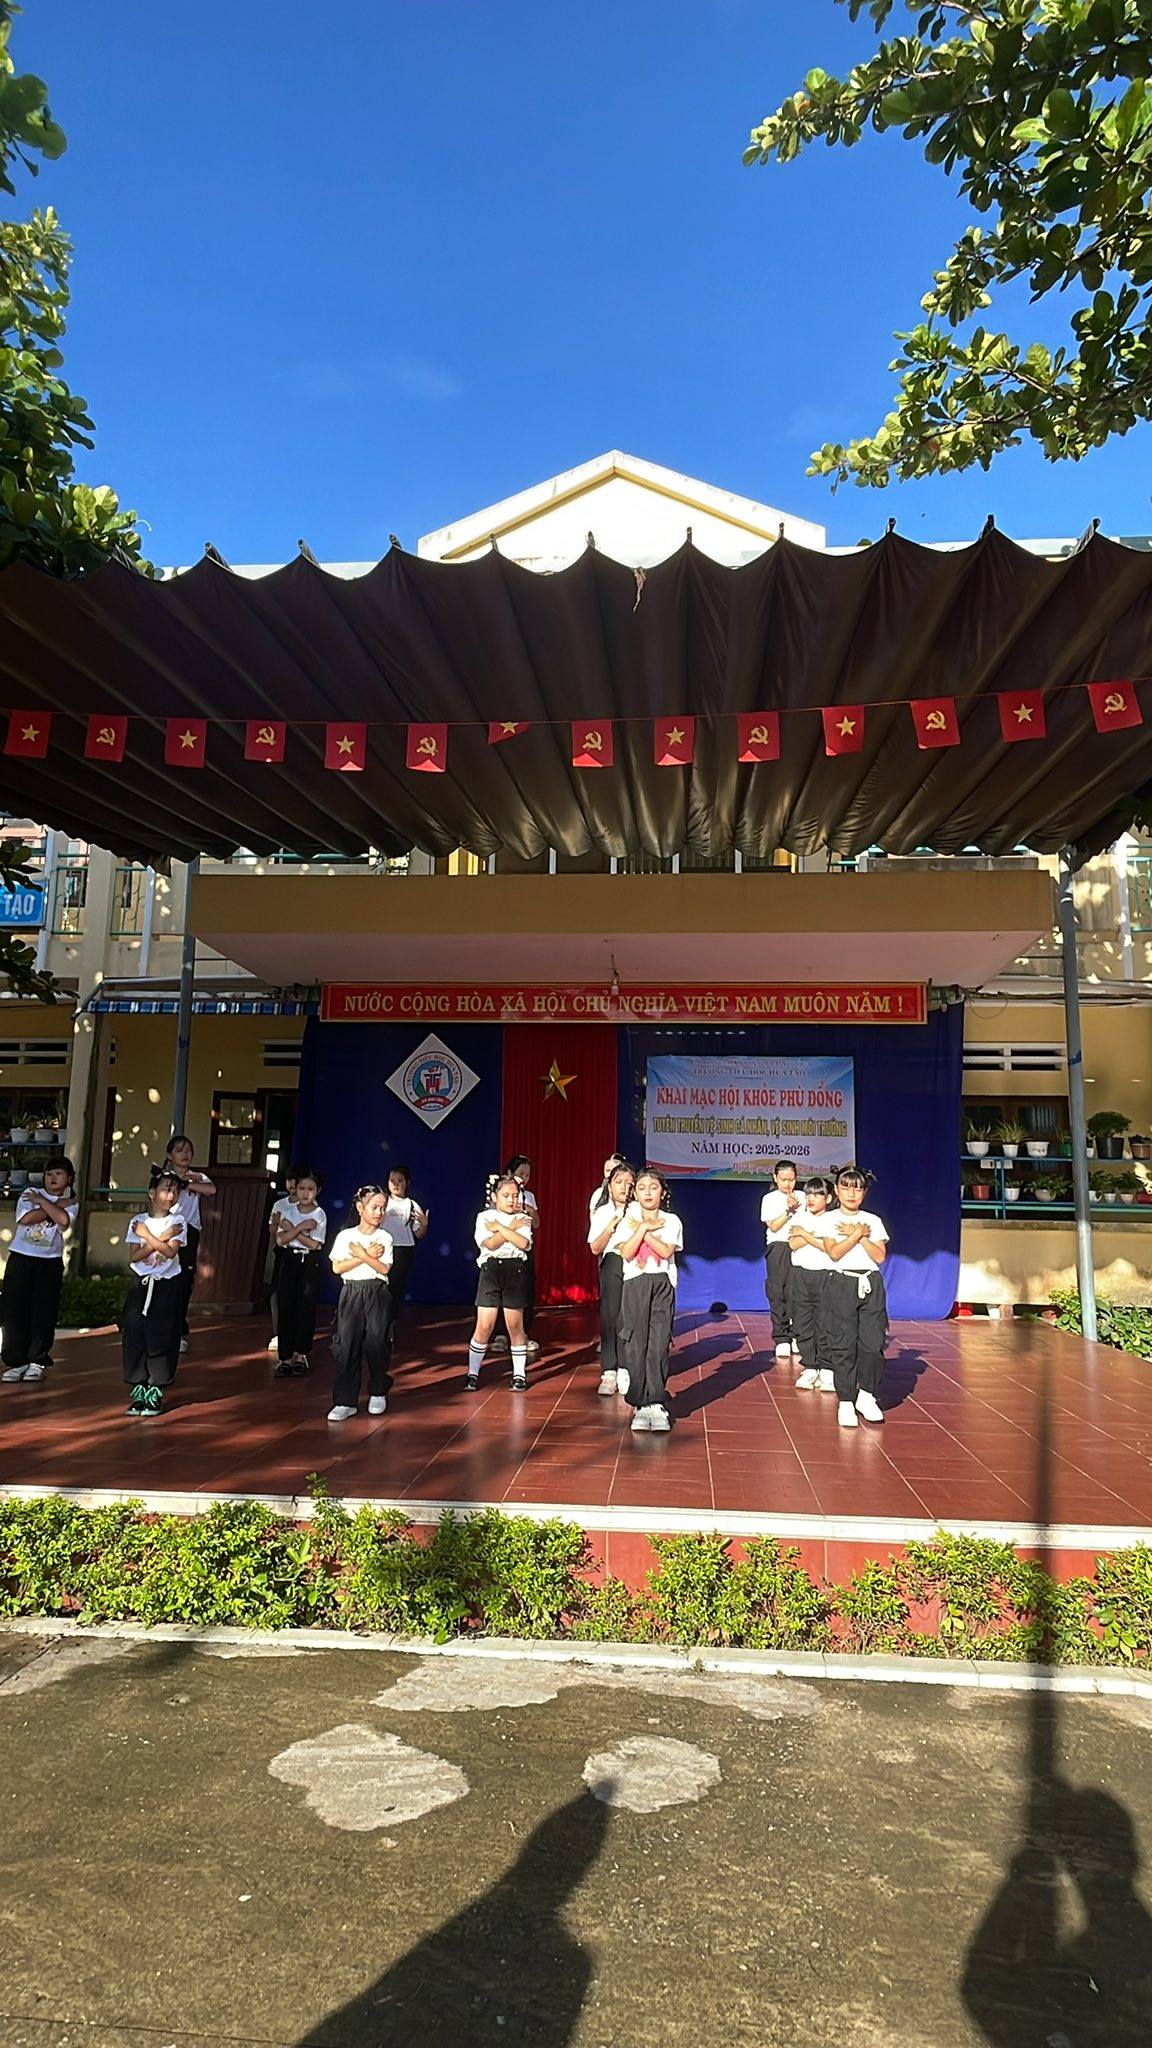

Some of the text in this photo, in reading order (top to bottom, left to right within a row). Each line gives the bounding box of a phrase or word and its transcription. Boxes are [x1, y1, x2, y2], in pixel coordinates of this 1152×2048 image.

[4, 894, 35, 919] TẠO
[344, 990, 394, 1012] NƯỚC
[400, 990, 450, 1016] CỘNG
[457, 991, 496, 1012] HÒA
[500, 991, 527, 1012] XÃ
[532, 990, 566, 1016] HỘI
[573, 989, 612, 1013] CHỦ
[618, 993, 679, 1013] NGHĨA
[684, 991, 729, 1016] VIỆT
[735, 996, 778, 1013] NAM
[784, 991, 839, 1013] MUÔN
[846, 991, 891, 1013] NĂM
[656, 1088, 687, 1104] KHAI
[690, 1088, 716, 1109] MẠC
[719, 1084, 740, 1110] HỘI
[780, 1085, 804, 1107] PHÙ
[807, 1081, 843, 1108] ĐỔNG
[716, 1118, 735, 1134] SINH
[692, 1140, 810, 1157] NĂM HỌC: 2025-2026
